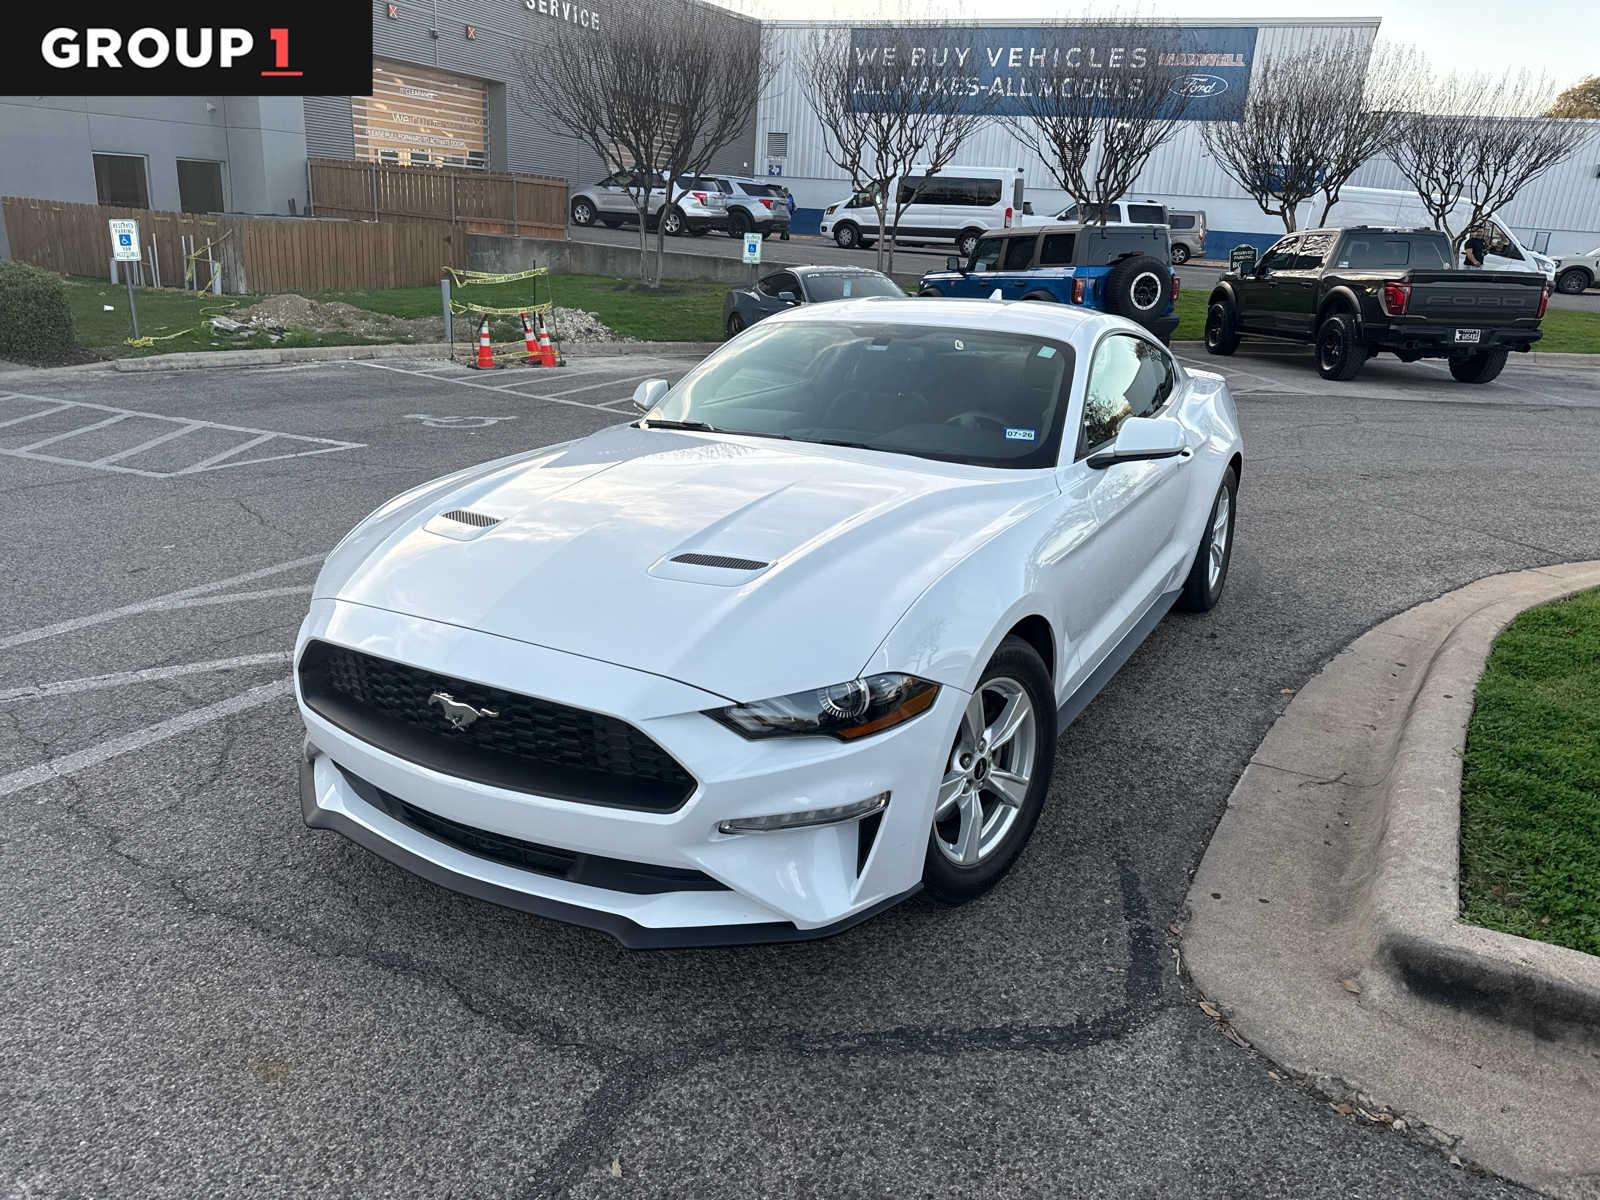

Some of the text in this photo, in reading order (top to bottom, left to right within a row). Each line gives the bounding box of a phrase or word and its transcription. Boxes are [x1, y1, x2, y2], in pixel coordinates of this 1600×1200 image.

[855, 47, 1147, 68] WE BUY VEHICLES
[853, 76, 891, 95] ALL
[1179, 77, 1217, 93] Ford
[1425, 295, 1526, 306] FORD
